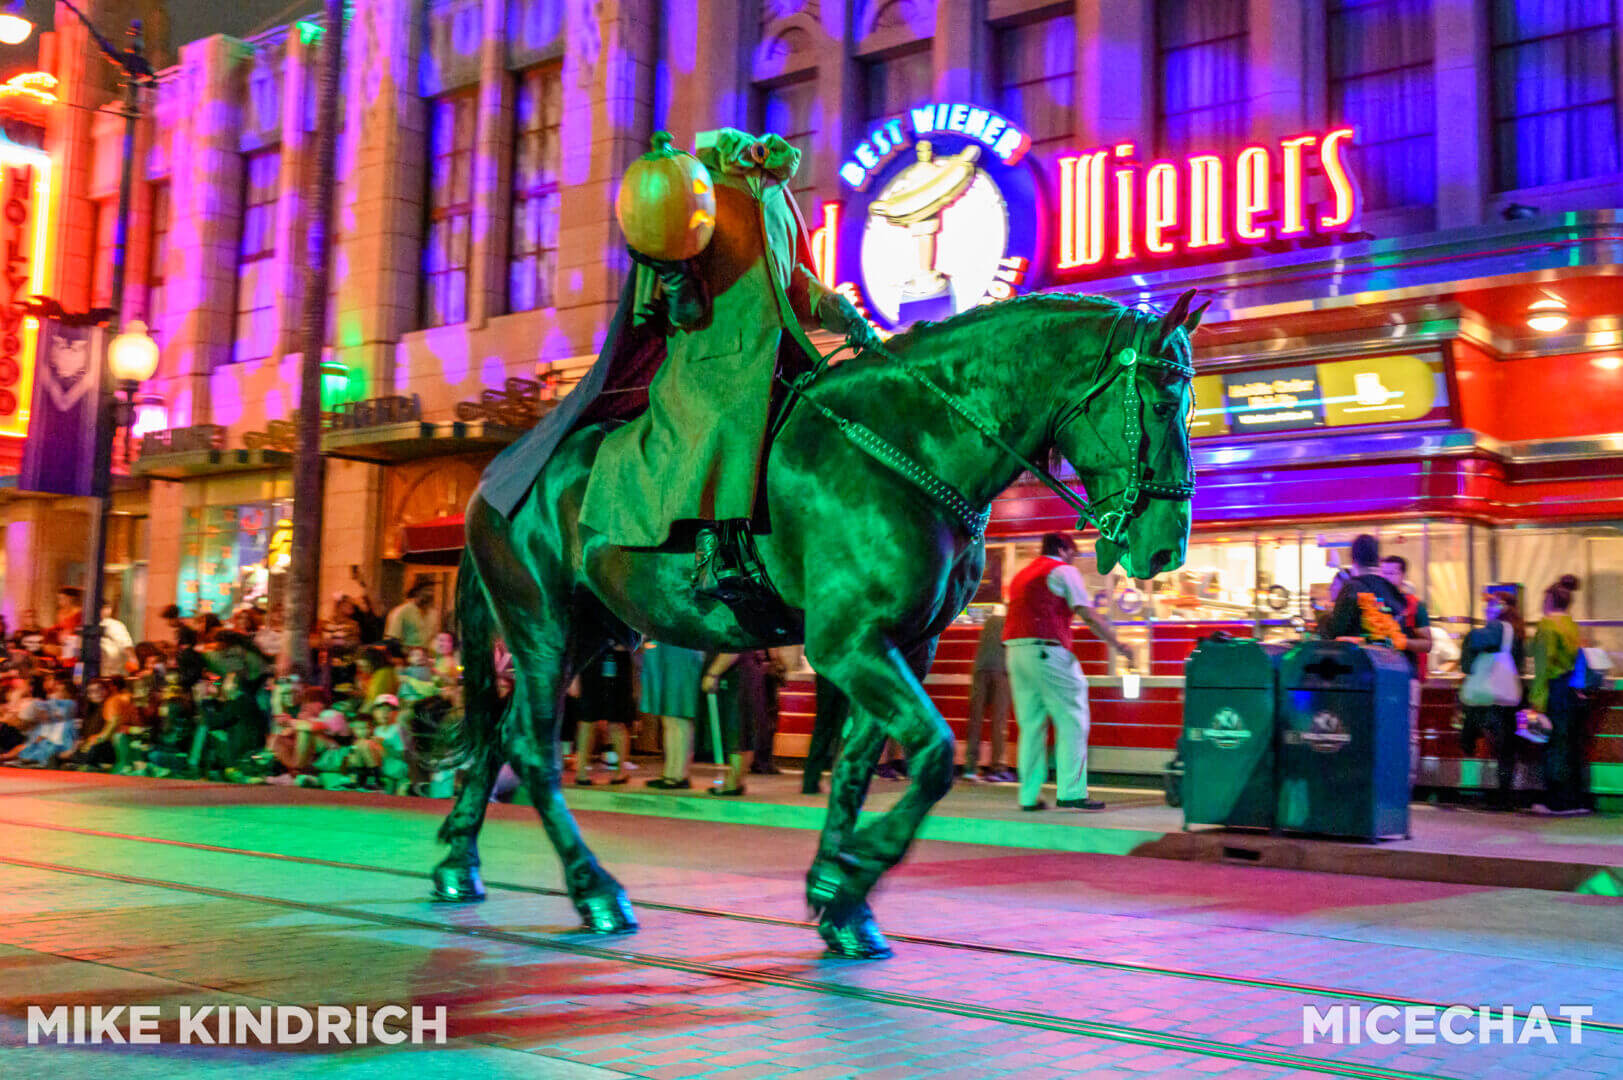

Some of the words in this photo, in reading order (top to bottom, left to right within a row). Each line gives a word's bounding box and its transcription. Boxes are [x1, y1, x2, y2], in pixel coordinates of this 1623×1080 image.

[840, 118, 906, 188] BEST
[910, 102, 1024, 161] WIENER
[1056, 129, 1355, 270] Wieners
